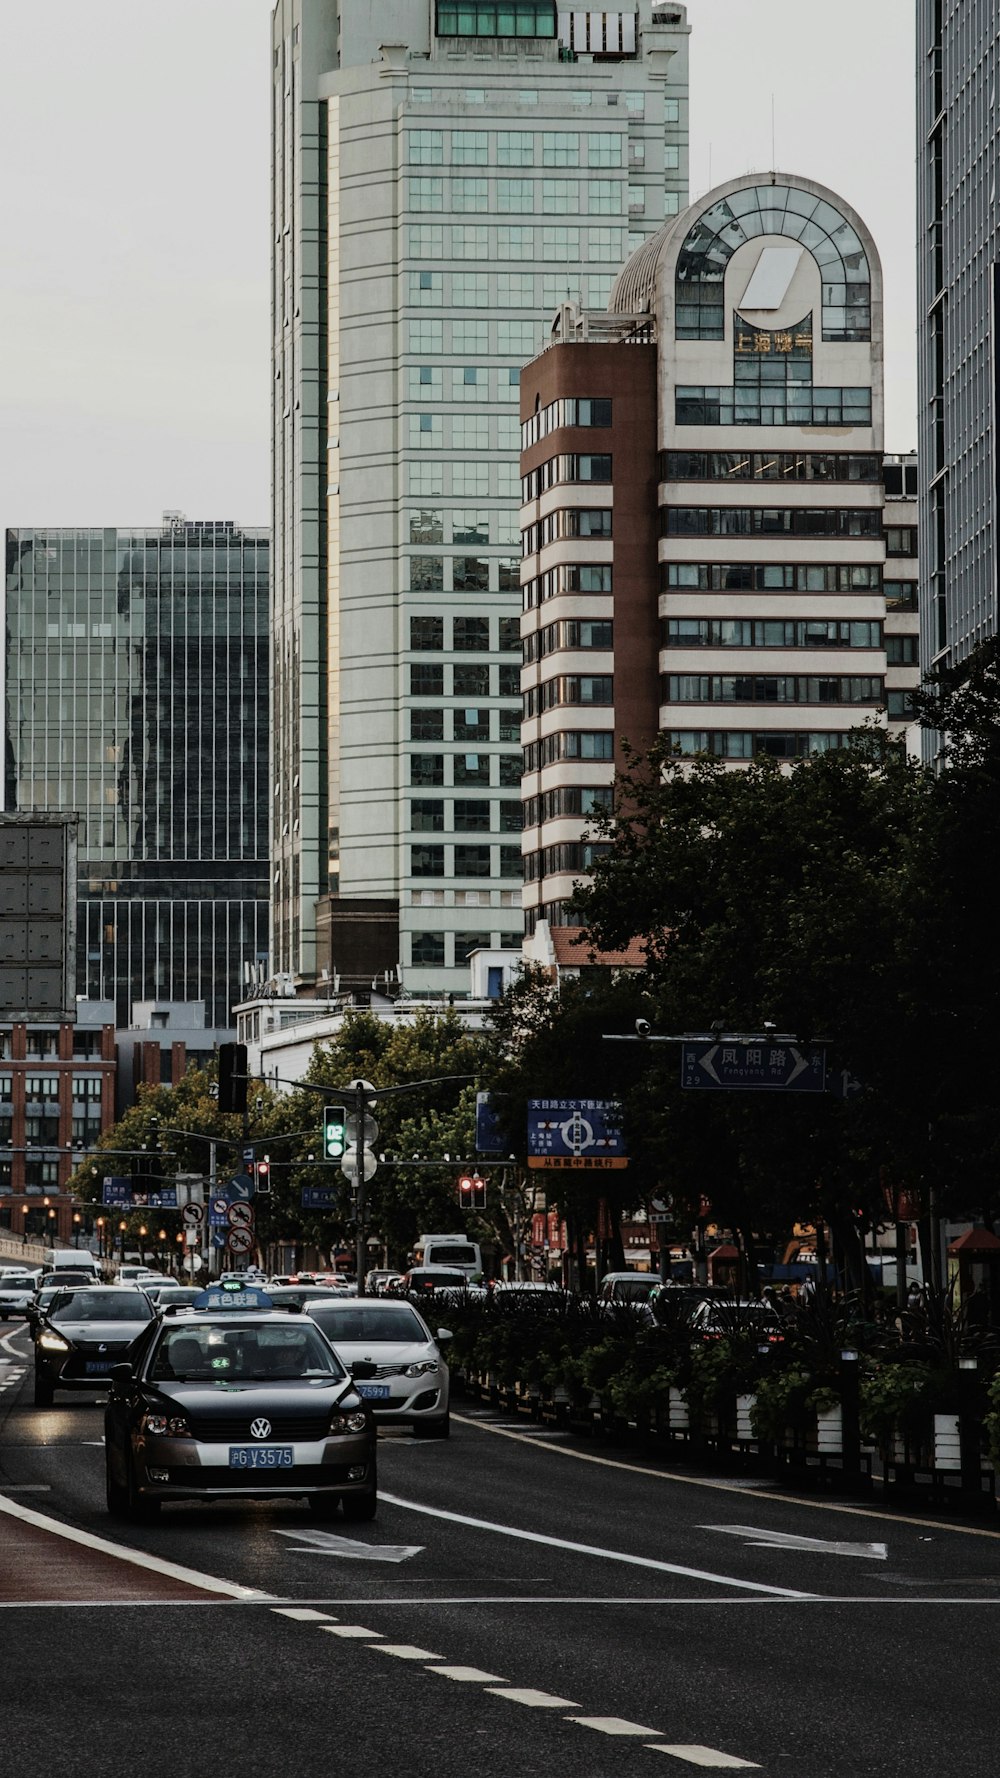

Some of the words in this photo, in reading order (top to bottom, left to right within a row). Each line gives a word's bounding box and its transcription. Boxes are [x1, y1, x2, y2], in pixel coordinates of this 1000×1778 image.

[685, 1053, 696, 1064] 西
[721, 1048, 787, 1067] 凤阳路
[811, 1056, 822, 1067] 东
[723, 1066, 765, 1077] Fengyang
[326, 1124, 343, 1141] 02
[544, 1157, 614, 1169] 从西藏中路绕行
[208, 1292, 258, 1307] 蓝色联盟
